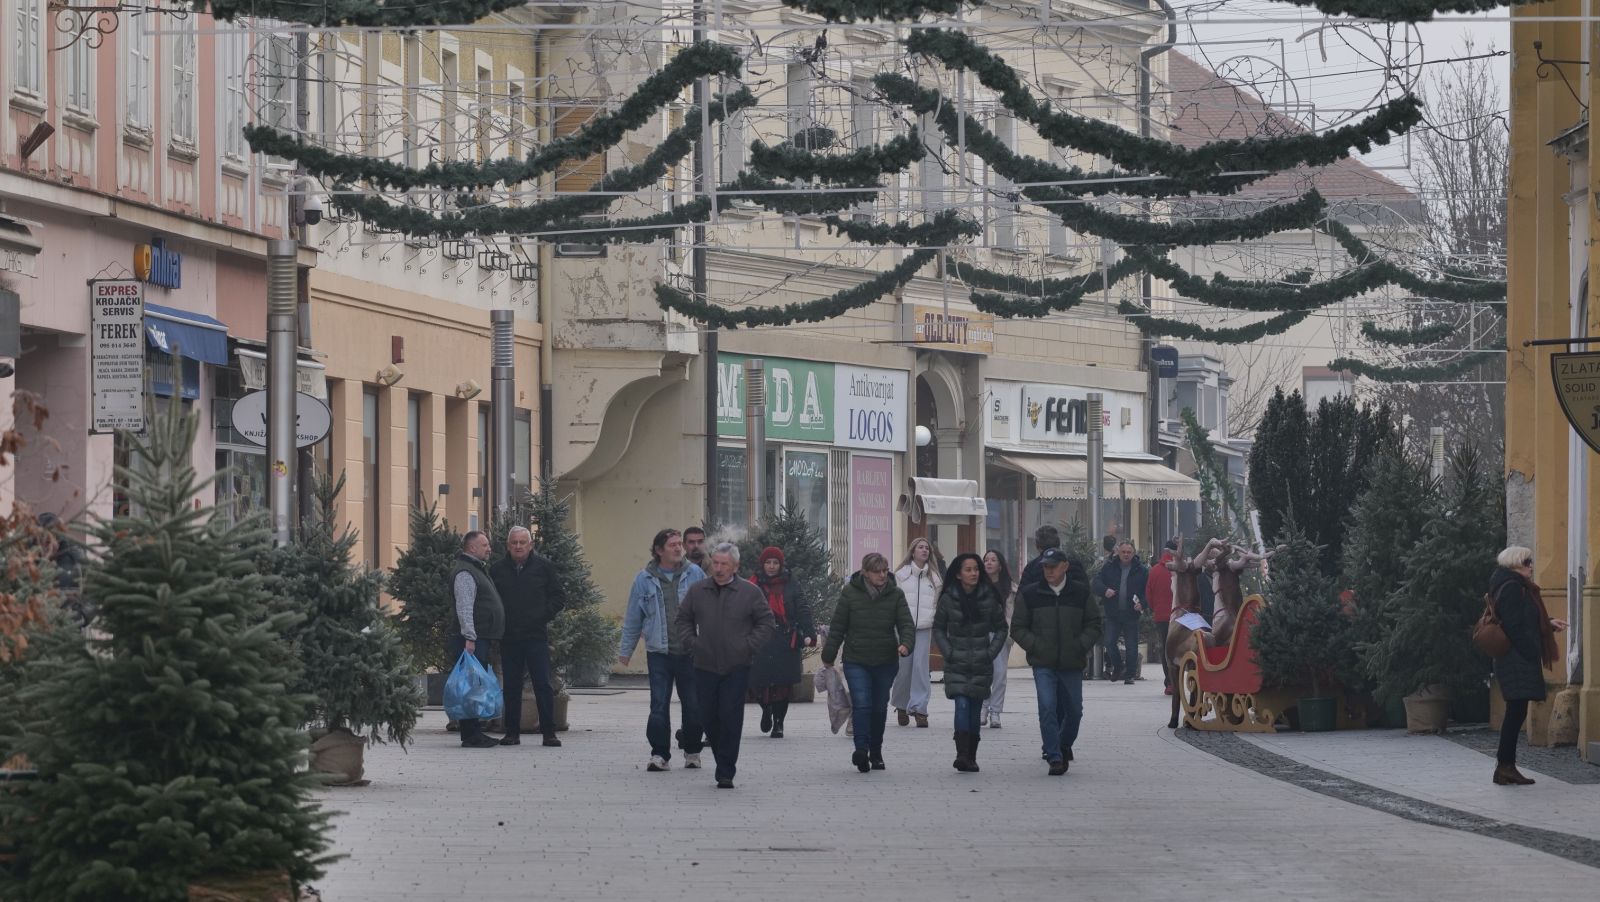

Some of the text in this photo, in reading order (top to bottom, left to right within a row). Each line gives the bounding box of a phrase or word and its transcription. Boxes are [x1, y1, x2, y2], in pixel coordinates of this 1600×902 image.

[151, 238, 182, 288] mlinar
[95, 295, 141, 306] KROJAČKI
[98, 285, 138, 296] EXPRES
[102, 307, 134, 316] SERVIS
[96, 323, 140, 339] "FEREK"
[924, 313, 943, 342] OLD
[945, 315, 968, 345] CITY
[717, 362, 825, 425] MDA
[848, 372, 895, 405] Antikvarijat
[1565, 383, 1596, 393] SOLID
[848, 407, 894, 443] LOGOS
[1045, 396, 1088, 434] FENI
